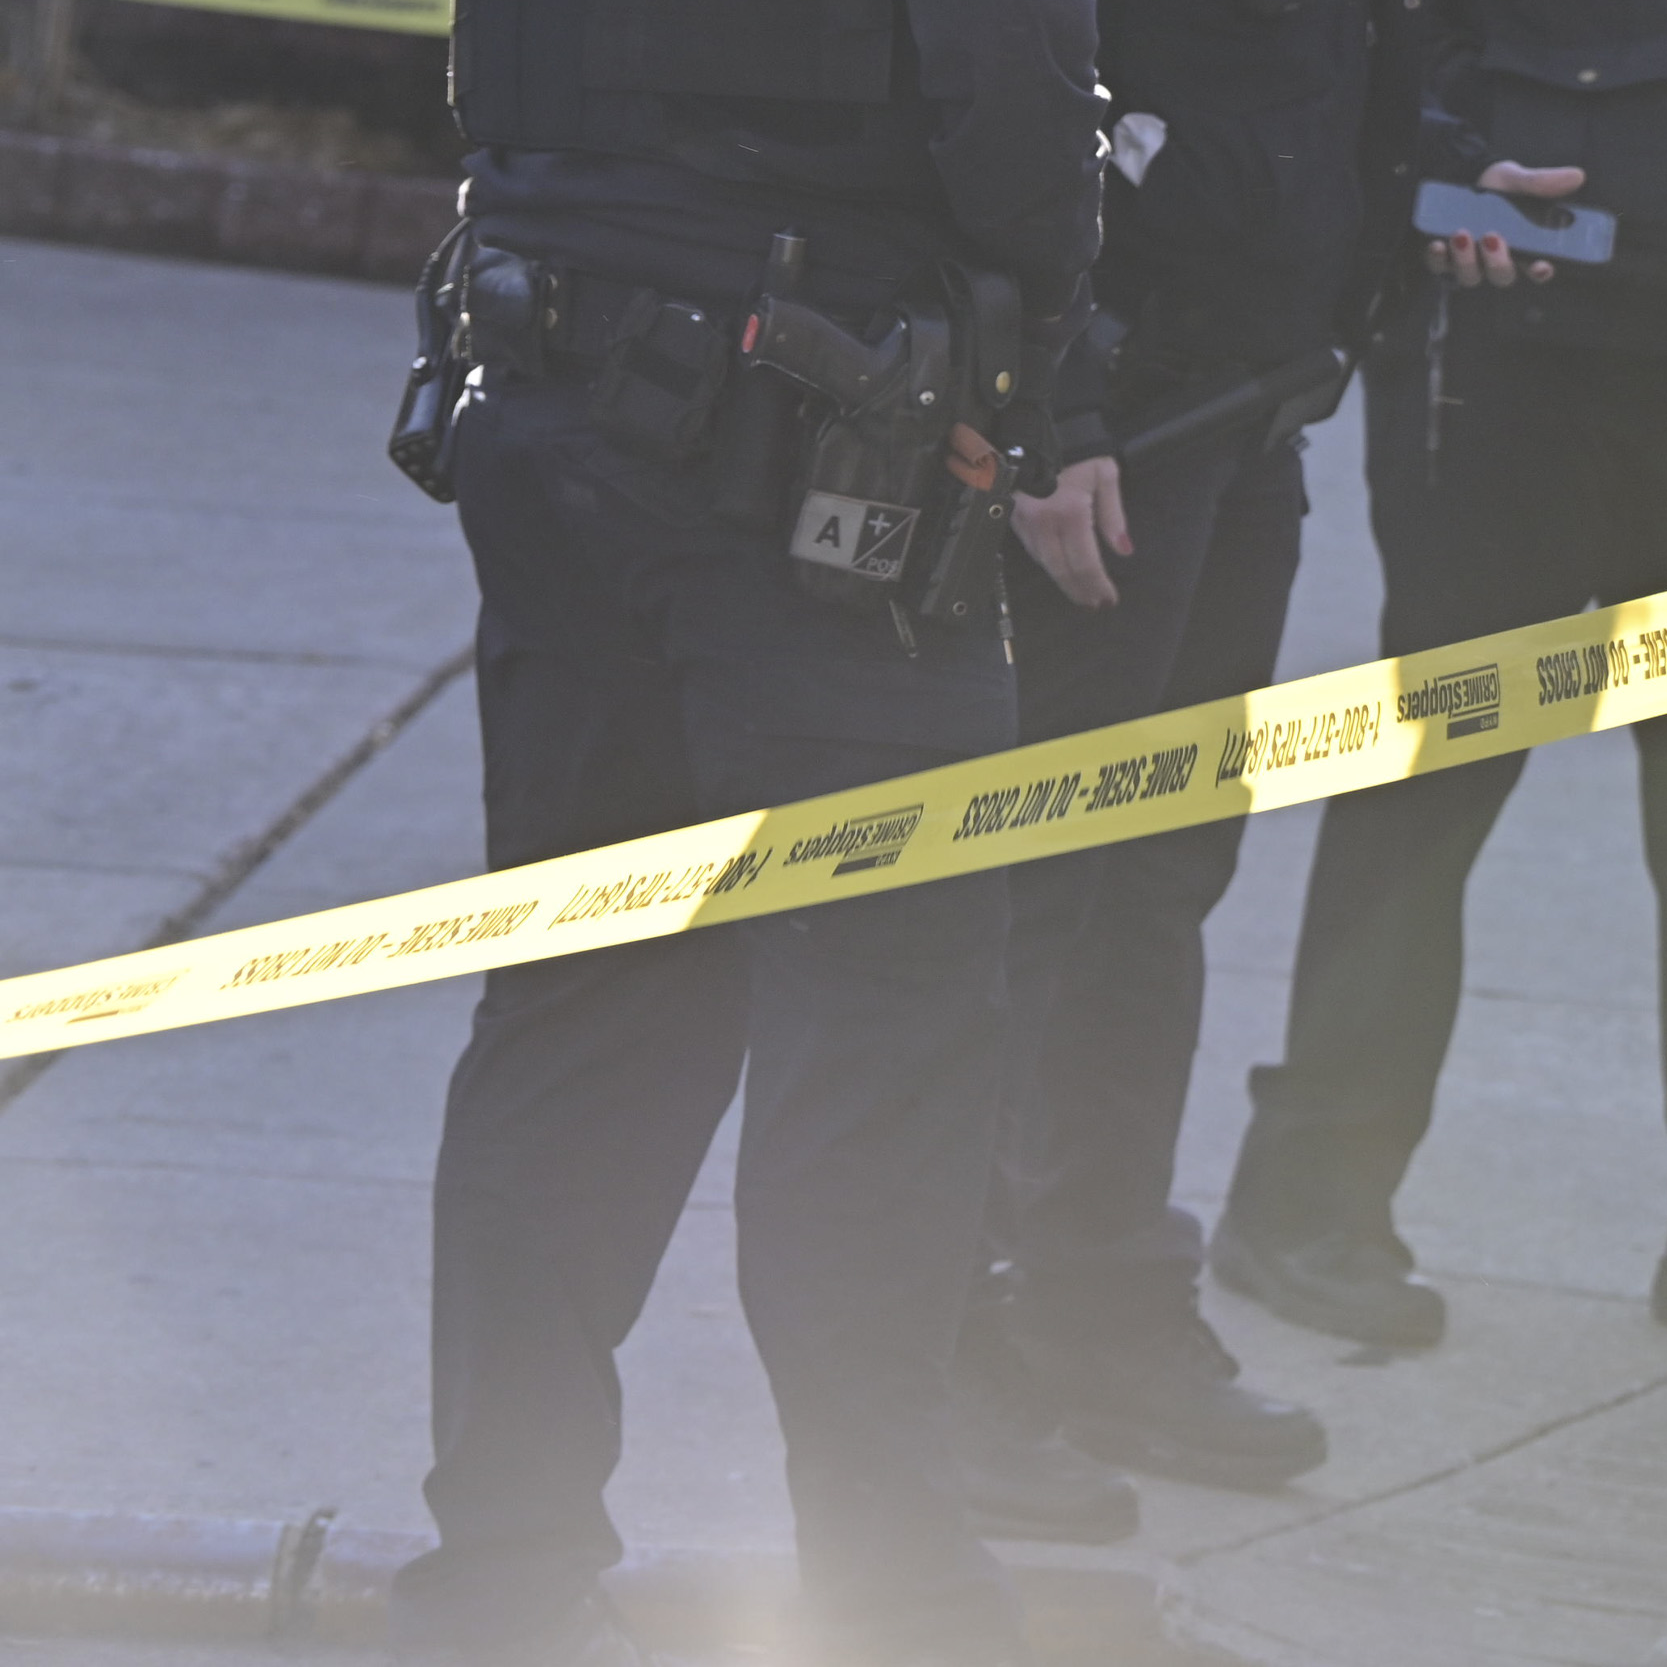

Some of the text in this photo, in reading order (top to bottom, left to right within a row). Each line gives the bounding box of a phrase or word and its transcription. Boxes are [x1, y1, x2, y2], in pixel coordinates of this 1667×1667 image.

[812, 516, 840, 549] A
[1537, 650, 1582, 706] CROSS
[1583, 644, 1609, 696] NOT
[1609, 639, 1630, 687] DO
[1216, 702, 1381, 788] 1-800-577-TIPS (8477)
[1046, 772, 1081, 822] DO
[1085, 755, 1147, 812] SCENE
[1140, 743, 1198, 800] CRIME
[953, 785, 1020, 841] CROSS
[1008, 778, 1055, 829] NOT
[613, 847, 773, 914] 1-800-577-TIPS
[386, 914, 473, 958] SCENE
[456, 900, 539, 944] CRIME
[219, 947, 311, 989] CROSS
[291, 938, 356, 976] NOT
